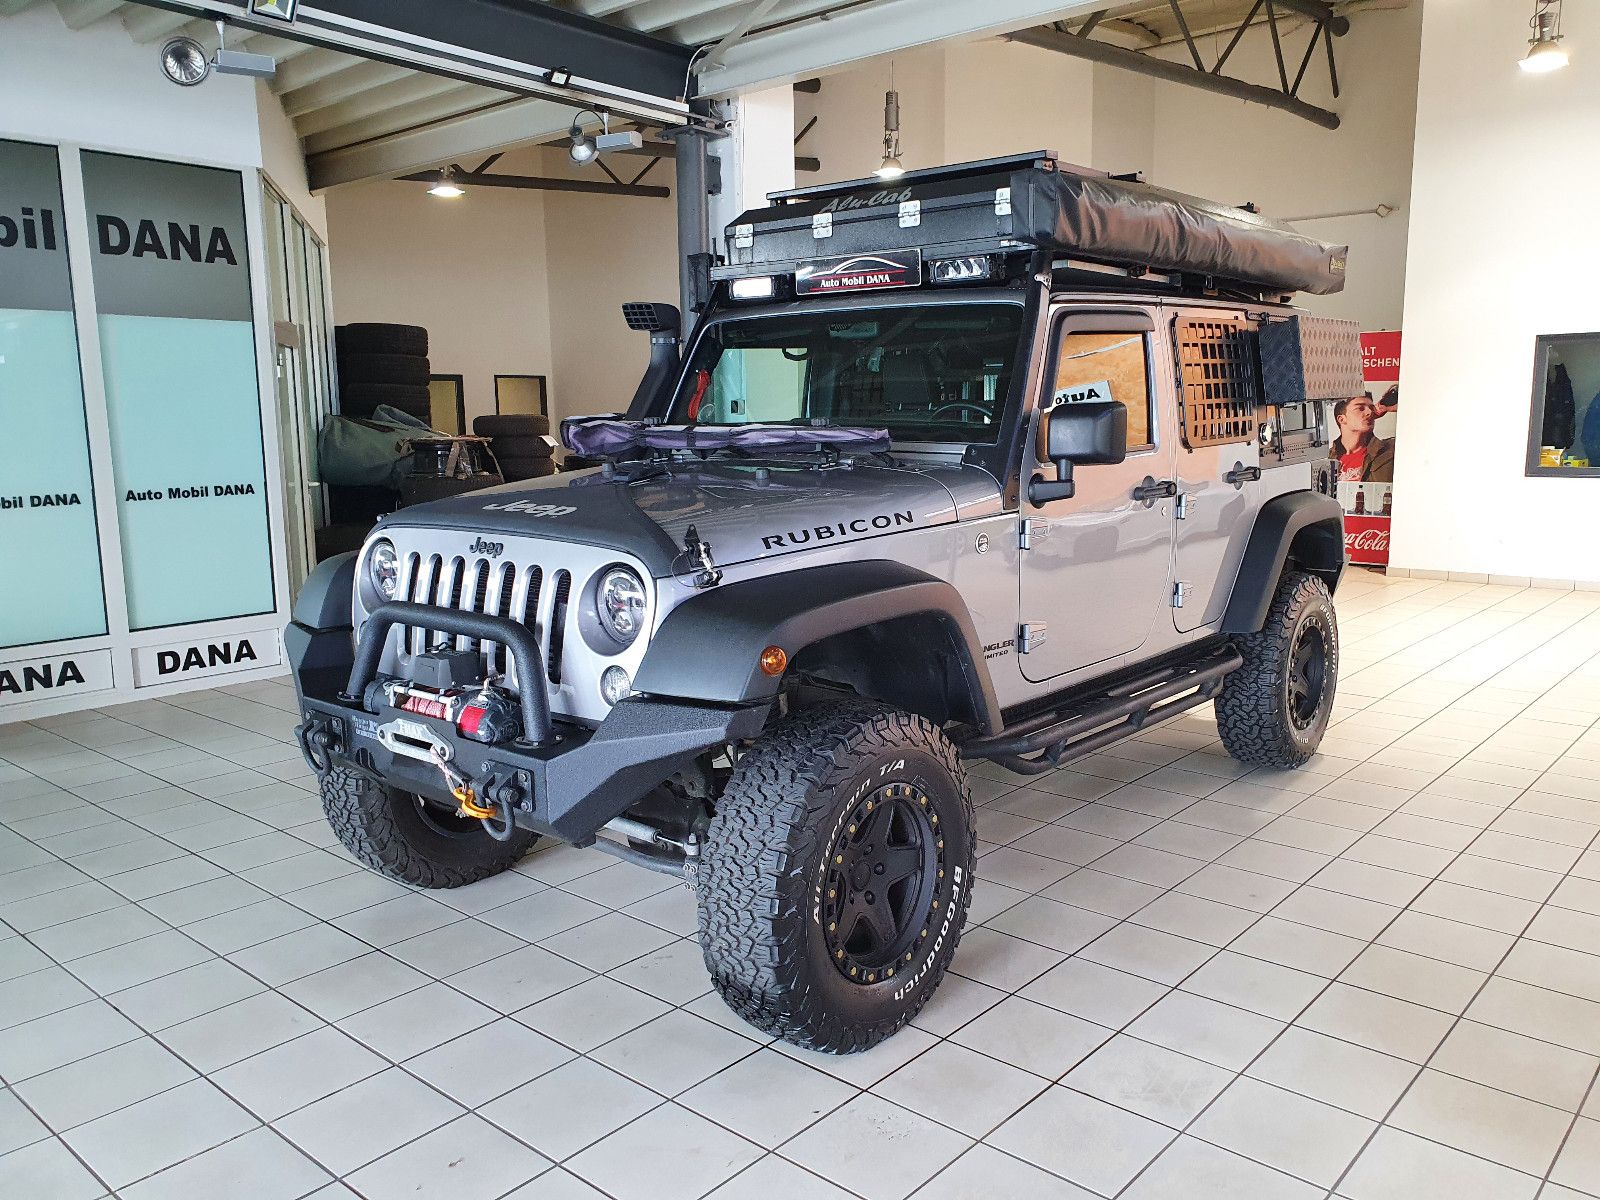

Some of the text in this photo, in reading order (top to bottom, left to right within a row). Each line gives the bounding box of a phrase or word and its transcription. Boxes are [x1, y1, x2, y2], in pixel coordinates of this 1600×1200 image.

[96, 214, 238, 265] DANA
[820, 278, 840, 288] Auto
[866, 273, 891, 284] DANA
[0, 492, 81, 510] bil DANA
[125, 483, 255, 502] Auto Mobil DANA
[482, 499, 578, 518] Jeep
[761, 510, 914, 550] RUBICON
[469, 536, 504, 558] Jeep
[983, 639, 1015, 652] NGLER
[984, 649, 1009, 660] IMITED
[0, 639, 257, 695] ANA DANA
[880, 759, 905, 777] T/A
[894, 865, 963, 1001] BFGoodrich
